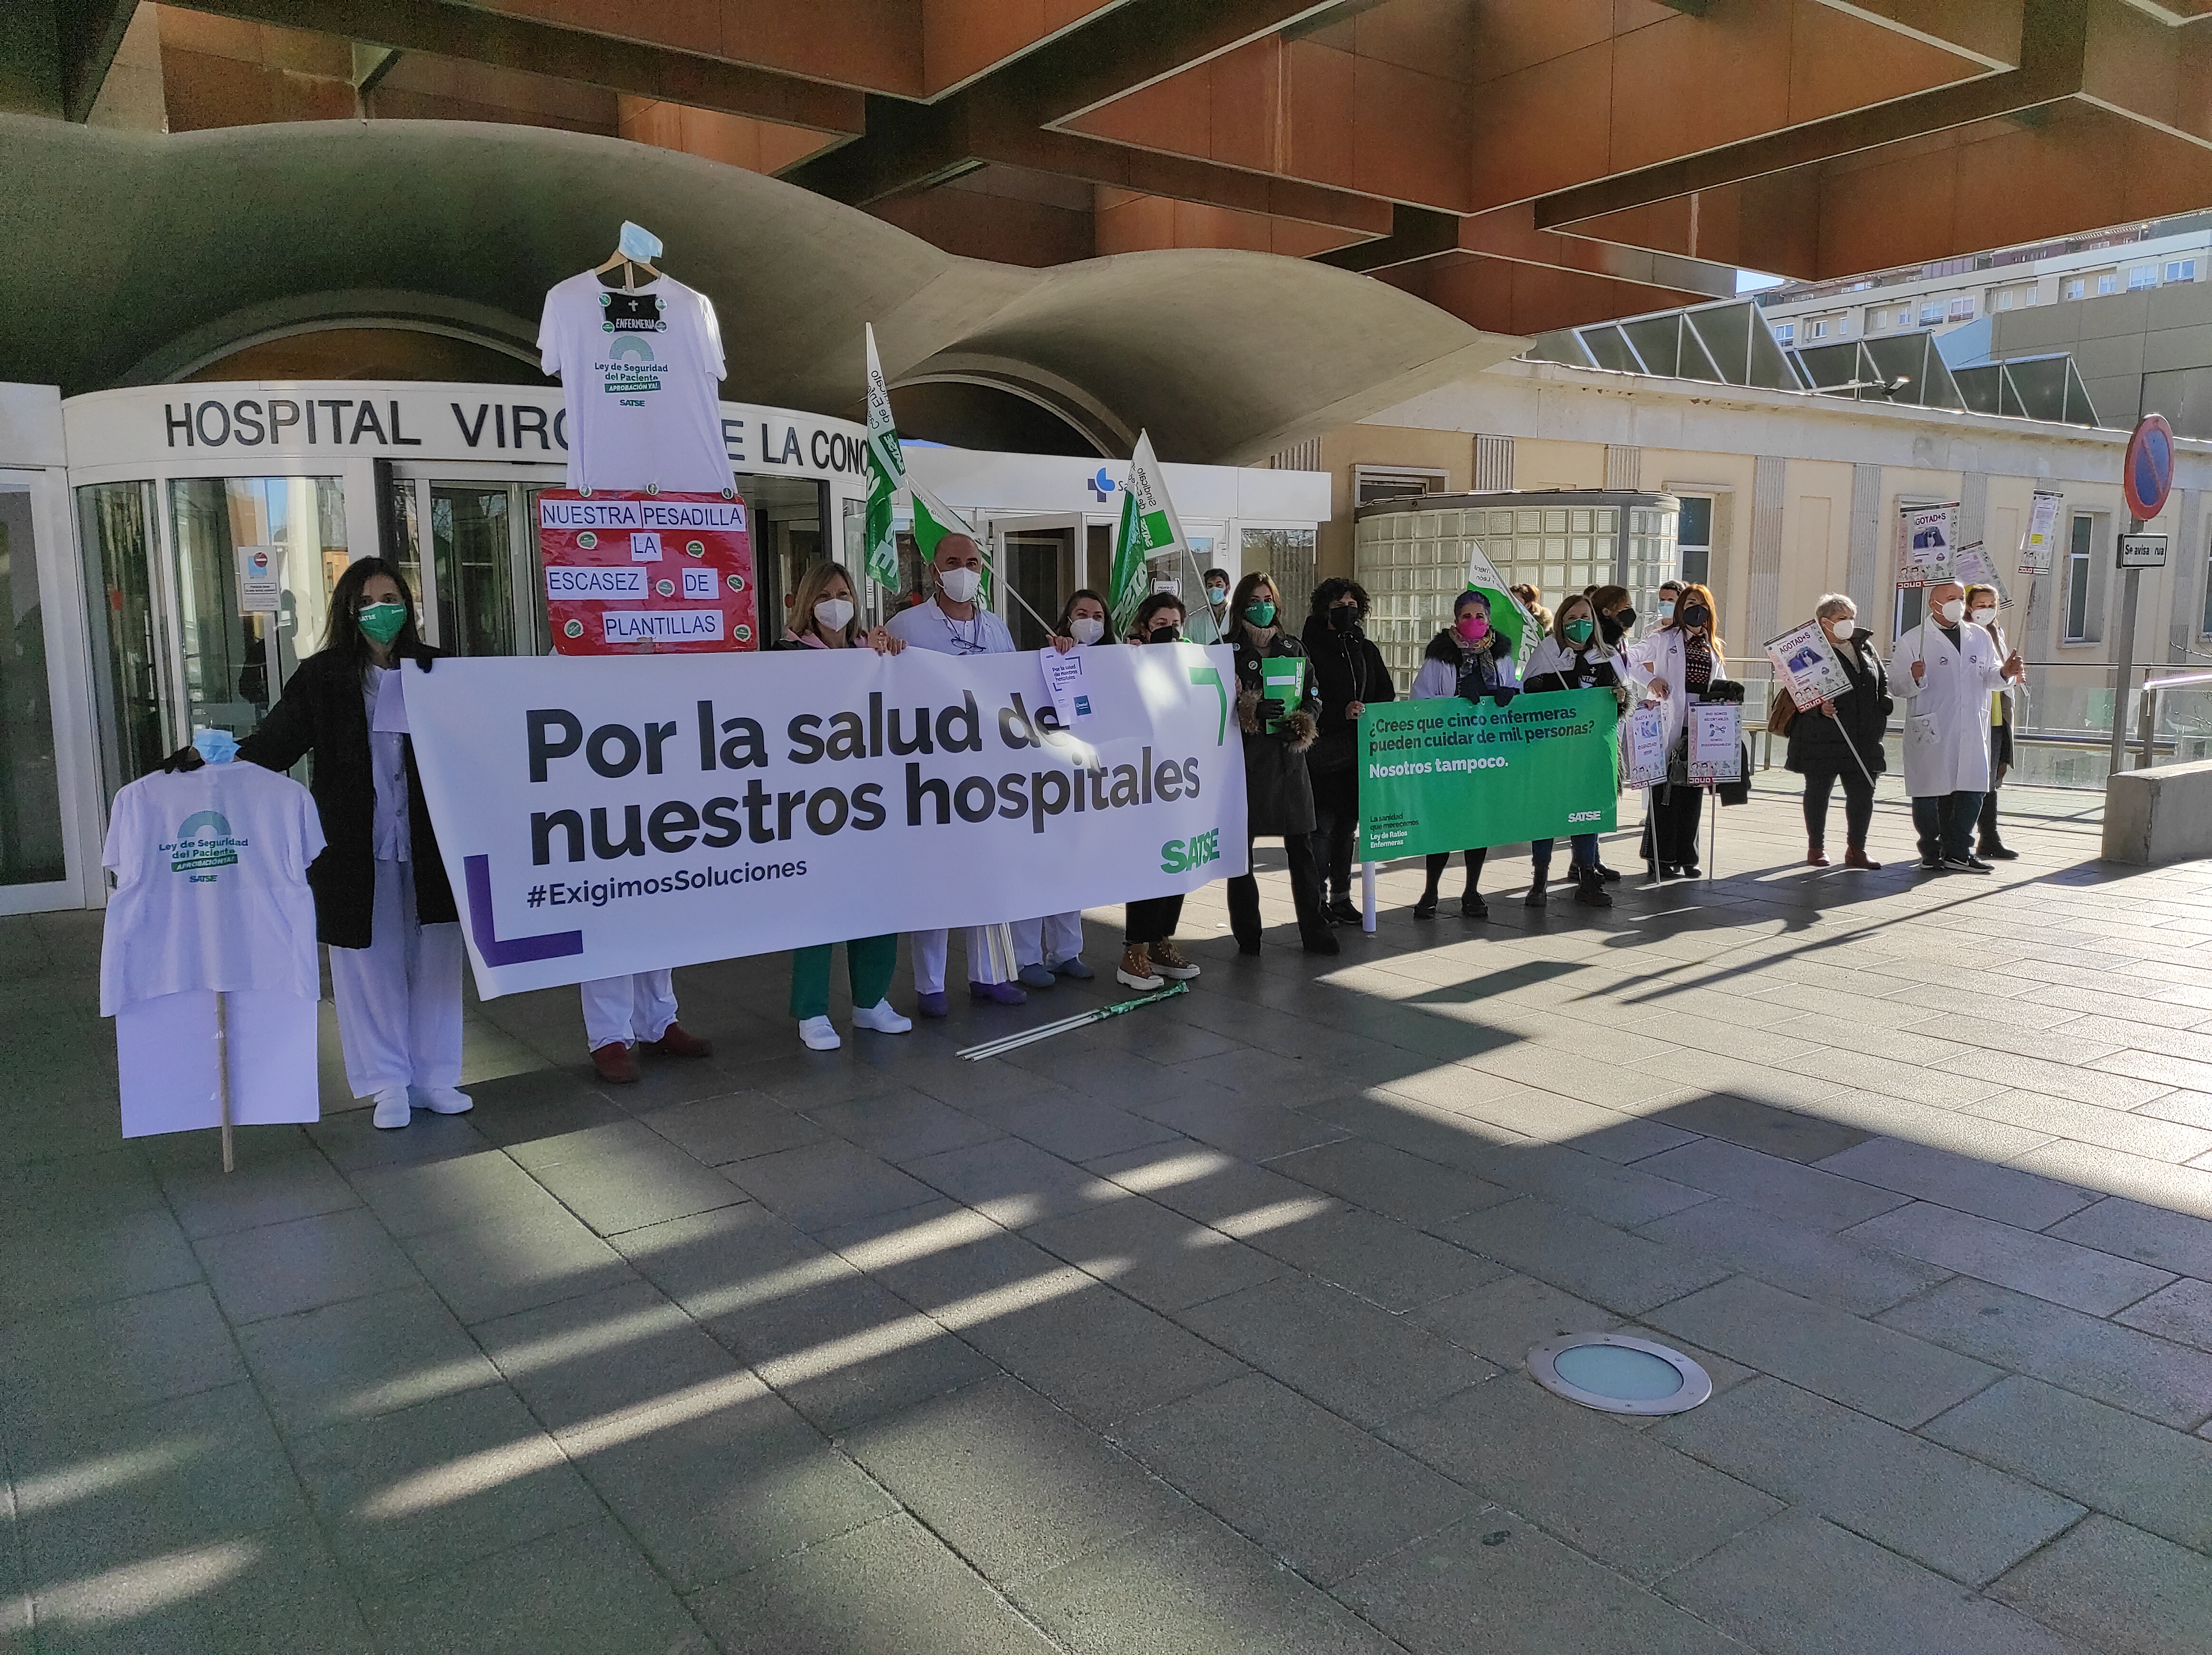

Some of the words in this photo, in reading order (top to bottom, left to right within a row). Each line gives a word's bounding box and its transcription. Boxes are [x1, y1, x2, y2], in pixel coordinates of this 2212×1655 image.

[615, 318, 656, 330] ENFERMERIA
[595, 362, 609, 372] Ley
[611, 363, 622, 371] de
[624, 364, 668, 374] Seguridad
[605, 373, 618, 381] del
[620, 373, 658, 381] Paciente
[164, 399, 422, 447] HOSPITAL
[720, 419, 746, 461] E
[761, 423, 804, 466] LA
[543, 505, 636, 524] NUESTRA
[643, 507, 742, 526] PESADILLA
[633, 536, 657, 553] LA
[2125, 544, 2133, 555] Se
[2134, 544, 2150, 555] avisa
[2153, 547, 2164, 556] rua
[549, 572, 640, 591] ESCASEZ
[685, 574, 709, 592] DE
[605, 616, 716, 636] PLANTILLAS
[1294, 662, 1303, 697] SATSE
[1369, 718, 1414, 738] ¿Crees
[1416, 717, 1444, 734] que
[1447, 713, 1487, 727] cinco
[1490, 708, 1577, 725] enfermeras
[526, 709, 677, 783] Por
[697, 700, 768, 770] la
[787, 688, 982, 765] salud
[998, 692, 1070, 750] de
[1369, 735, 1421, 756] pueden
[1424, 730, 1474, 747] cuidar
[1476, 729, 1496, 744] de
[1499, 726, 1523, 742] mil
[1525, 720, 1595, 744] personas?
[1369, 760, 1432, 778] Nosotros
[1435, 756, 1509, 774] tampoco.
[530, 779, 887, 866] nuestros
[905, 746, 1200, 834] hospitales
[1379, 812, 1403, 821] sanidad
[1383, 820, 1419, 828] merecemos
[1567, 810, 1601, 823] SATSE
[180, 840, 195, 848] de
[198, 838, 248, 848] Seguridad
[1390, 830, 1408, 838] Ratios
[1160, 828, 1220, 874] SATSE
[1370, 839, 1404, 848] Enfermeras
[172, 850, 189, 859] del
[192, 848, 235, 857] Paciente
[527, 860, 808, 908] #ExigimosSoluciones
